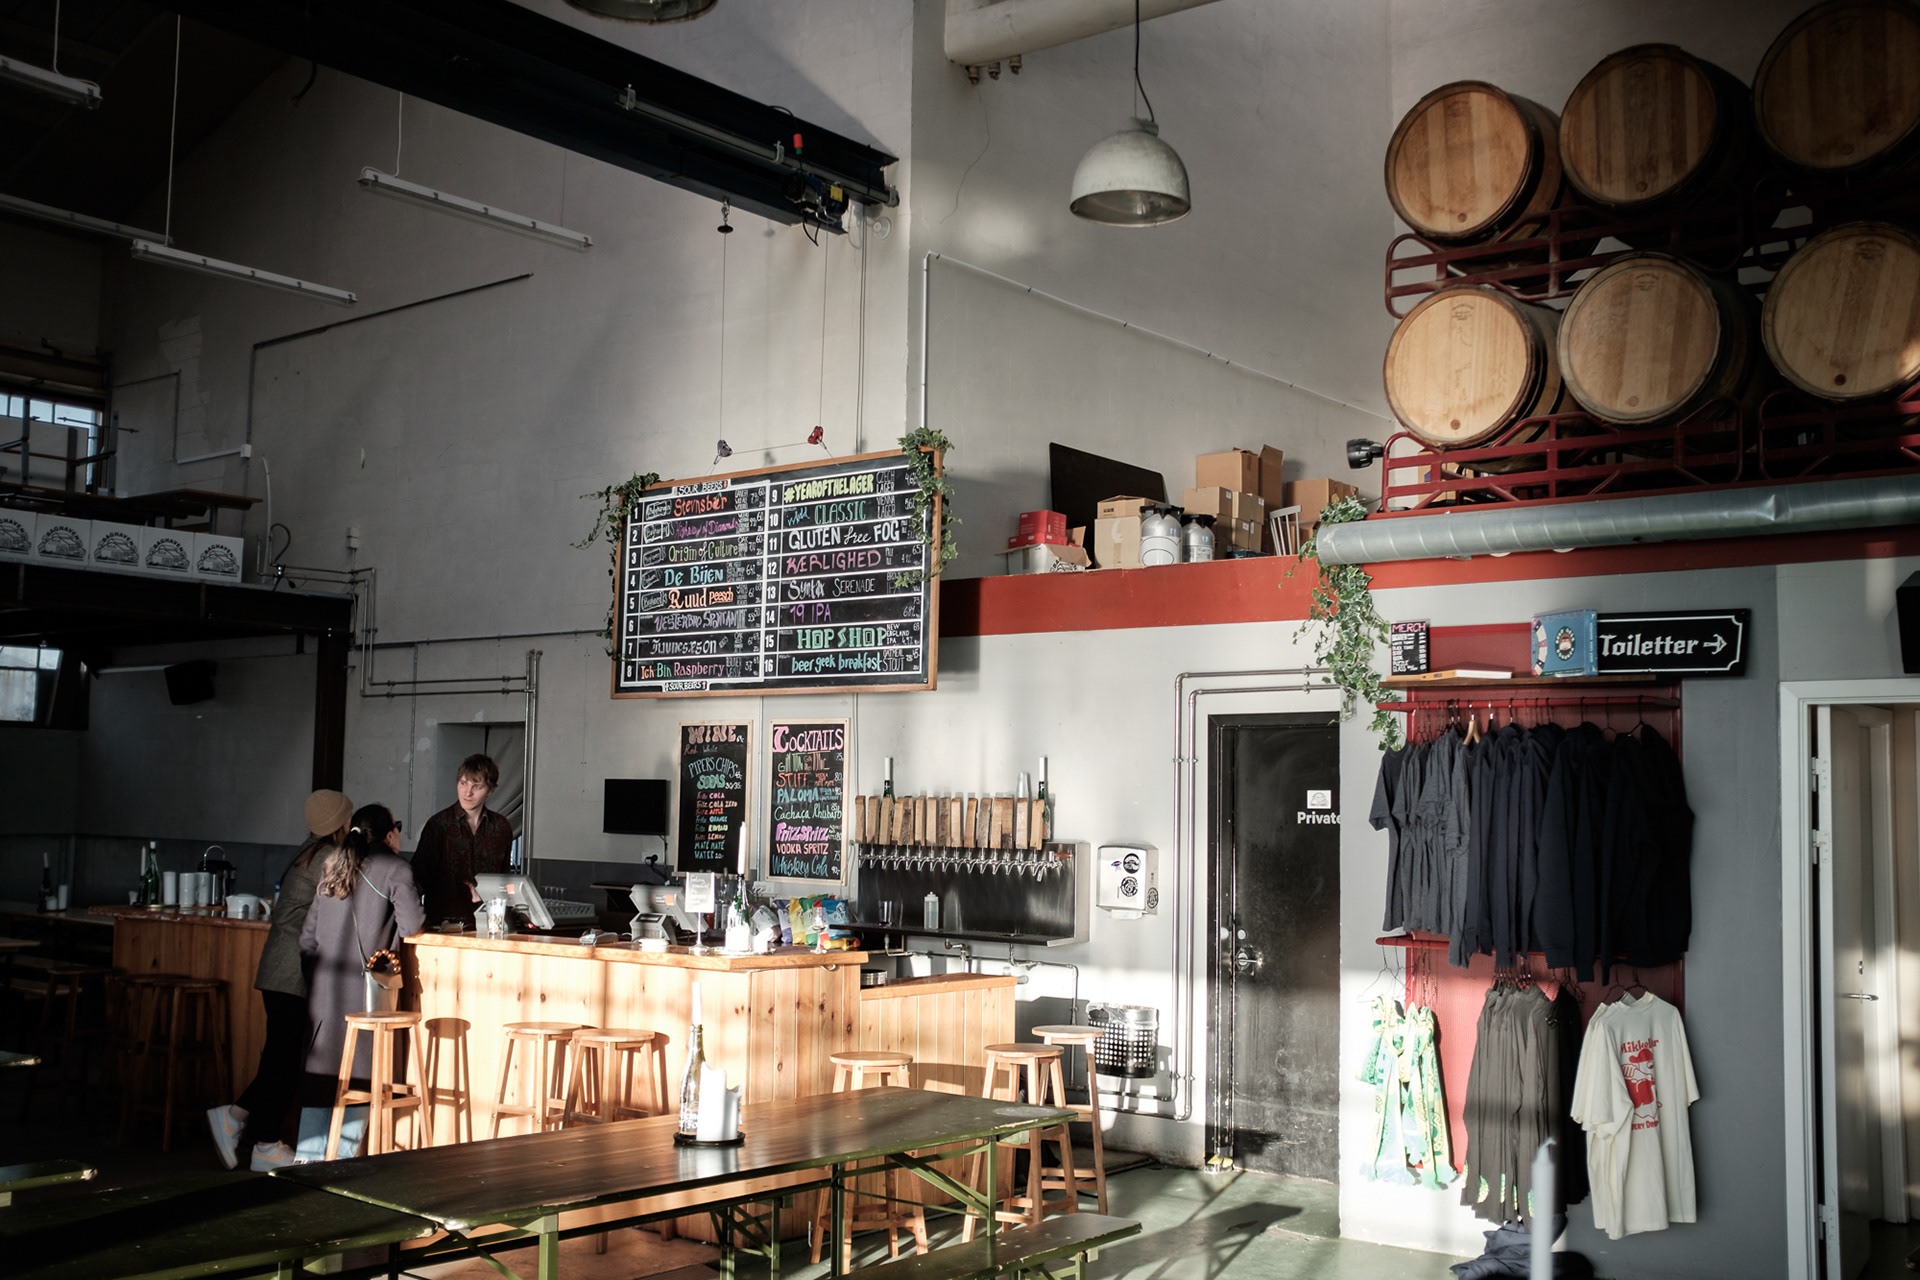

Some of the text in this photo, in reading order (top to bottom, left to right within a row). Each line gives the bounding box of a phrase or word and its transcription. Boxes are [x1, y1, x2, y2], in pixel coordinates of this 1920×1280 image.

[679, 482, 722, 495] SOUR BEERS
[772, 490, 778, 502] 9
[634, 508, 638, 519] 1
[770, 515, 778, 526] 10
[815, 500, 866, 524] CLASSIC
[46, 526, 80, 542] BAGHAVEN
[102, 531, 134, 546] BAGHAVEN
[633, 530, 637, 542] 2
[769, 520, 900, 550] 11 GLUTEN free FOG
[153, 537, 184, 552] BAGHAVEN
[203, 544, 234, 558] BAGHAVEN
[631, 553, 637, 564] 3
[669, 545, 697, 562] Origin
[698, 541, 707, 561] of
[708, 540, 738, 559] Culture
[768, 562, 776, 575] 12
[630, 575, 635, 586] 4
[766, 587, 776, 599] 13
[832, 578, 875, 597] SERENADE
[630, 598, 634, 610] 5
[668, 587, 707, 609] Ruud
[766, 611, 775, 624] 14
[790, 604, 805, 624] 19
[811, 603, 832, 624] IPA
[629, 620, 634, 632] 6
[1392, 622, 1426, 633] MERCH
[765, 635, 774, 648] 15
[797, 628, 834, 649] HOP
[838, 627, 886, 648] SHOP
[1599, 633, 1699, 657] Toiletter
[628, 643, 633, 654] 7
[764, 652, 882, 673] 16 beer geek breakfast
[882, 657, 904, 671] STOUT
[627, 666, 632, 677] 8
[641, 666, 654, 679] Ich
[657, 663, 672, 677] Bin
[674, 662, 725, 677] Raspberry
[669, 681, 701, 690] SOUR BEERS
[772, 726, 844, 753] COCKTAILS
[684, 744, 697, 755] Red
[697, 774, 725, 789] SODAS
[776, 773, 809, 787] STIFF
[777, 787, 818, 804] PALOMA
[774, 805, 810, 823] Cachaça
[694, 851, 714, 859] WATER
[776, 843, 802, 854] VODKA
[803, 843, 829, 854] SPRITZ
[811, 854, 828, 877] Cola
